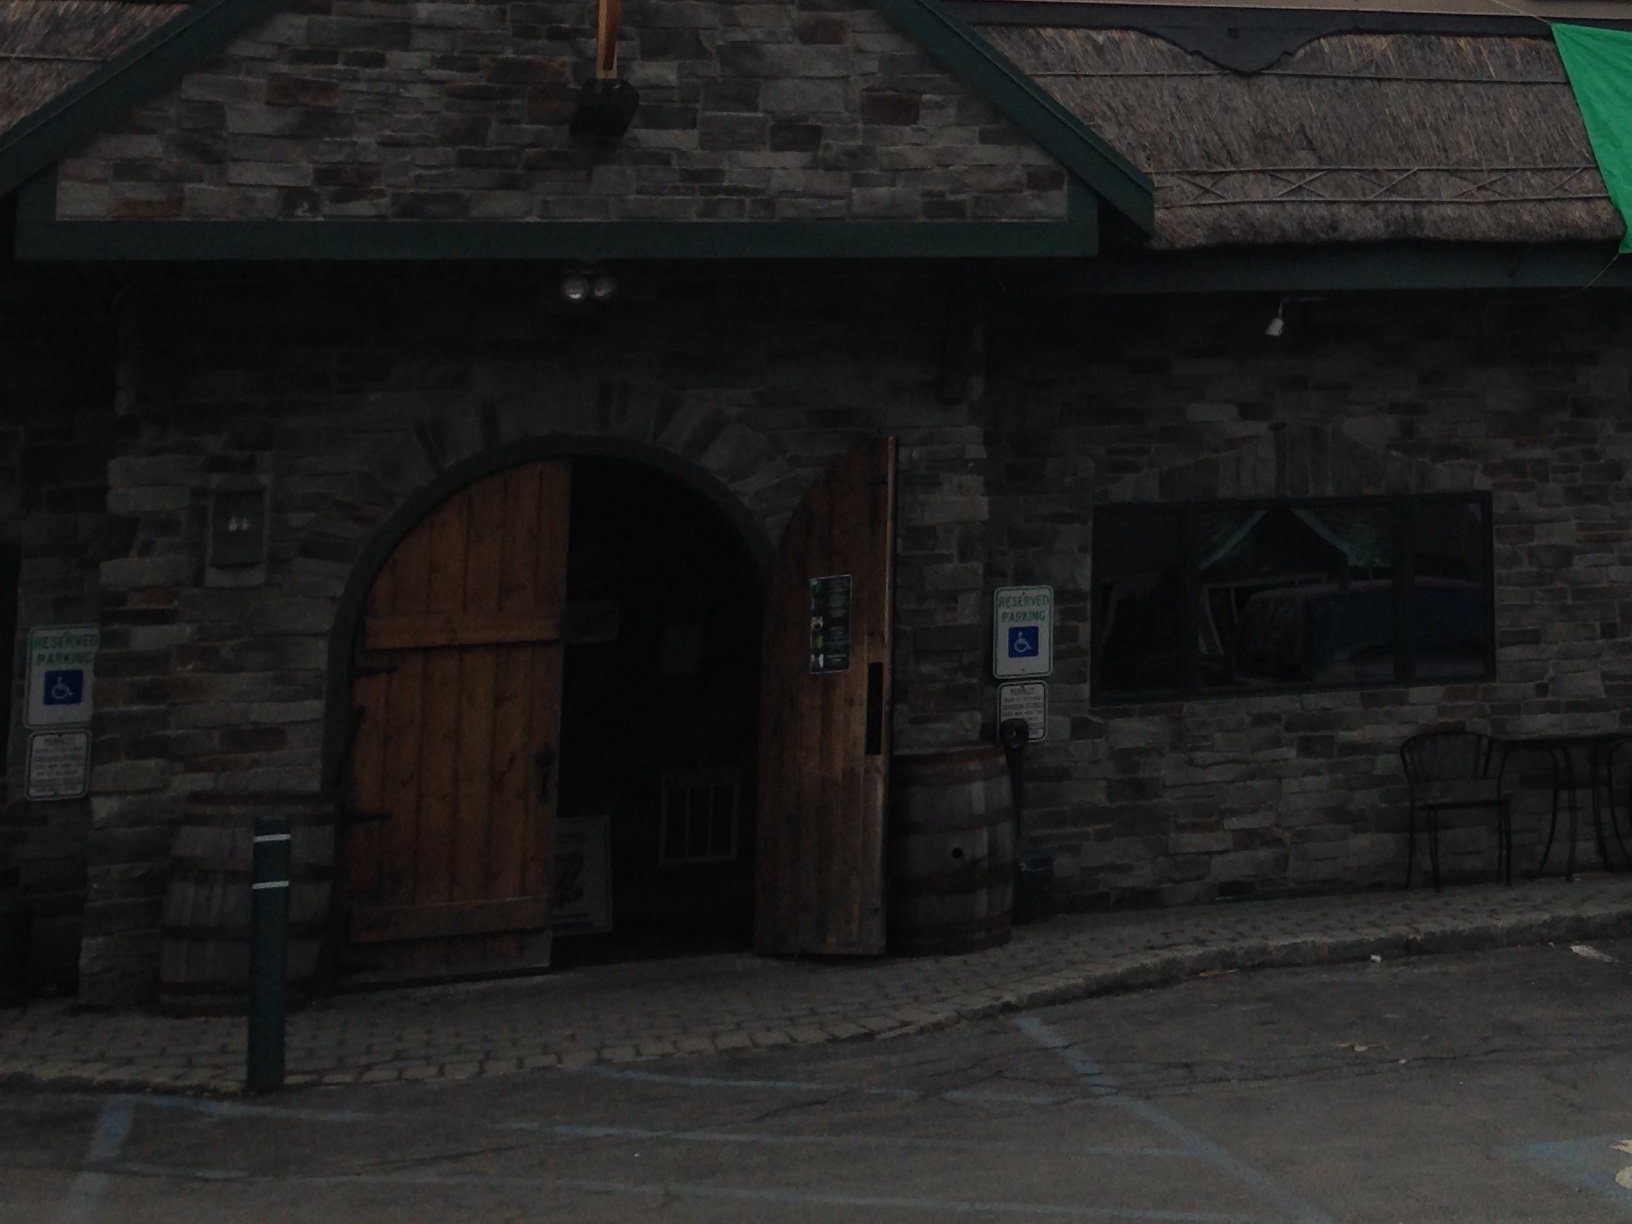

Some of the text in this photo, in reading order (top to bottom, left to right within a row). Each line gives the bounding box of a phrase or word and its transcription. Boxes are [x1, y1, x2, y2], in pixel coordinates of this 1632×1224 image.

[998, 594, 1049, 609] RESERVED
[1001, 610, 1046, 623] PARKING
[32, 633, 98, 649] RESERVED
